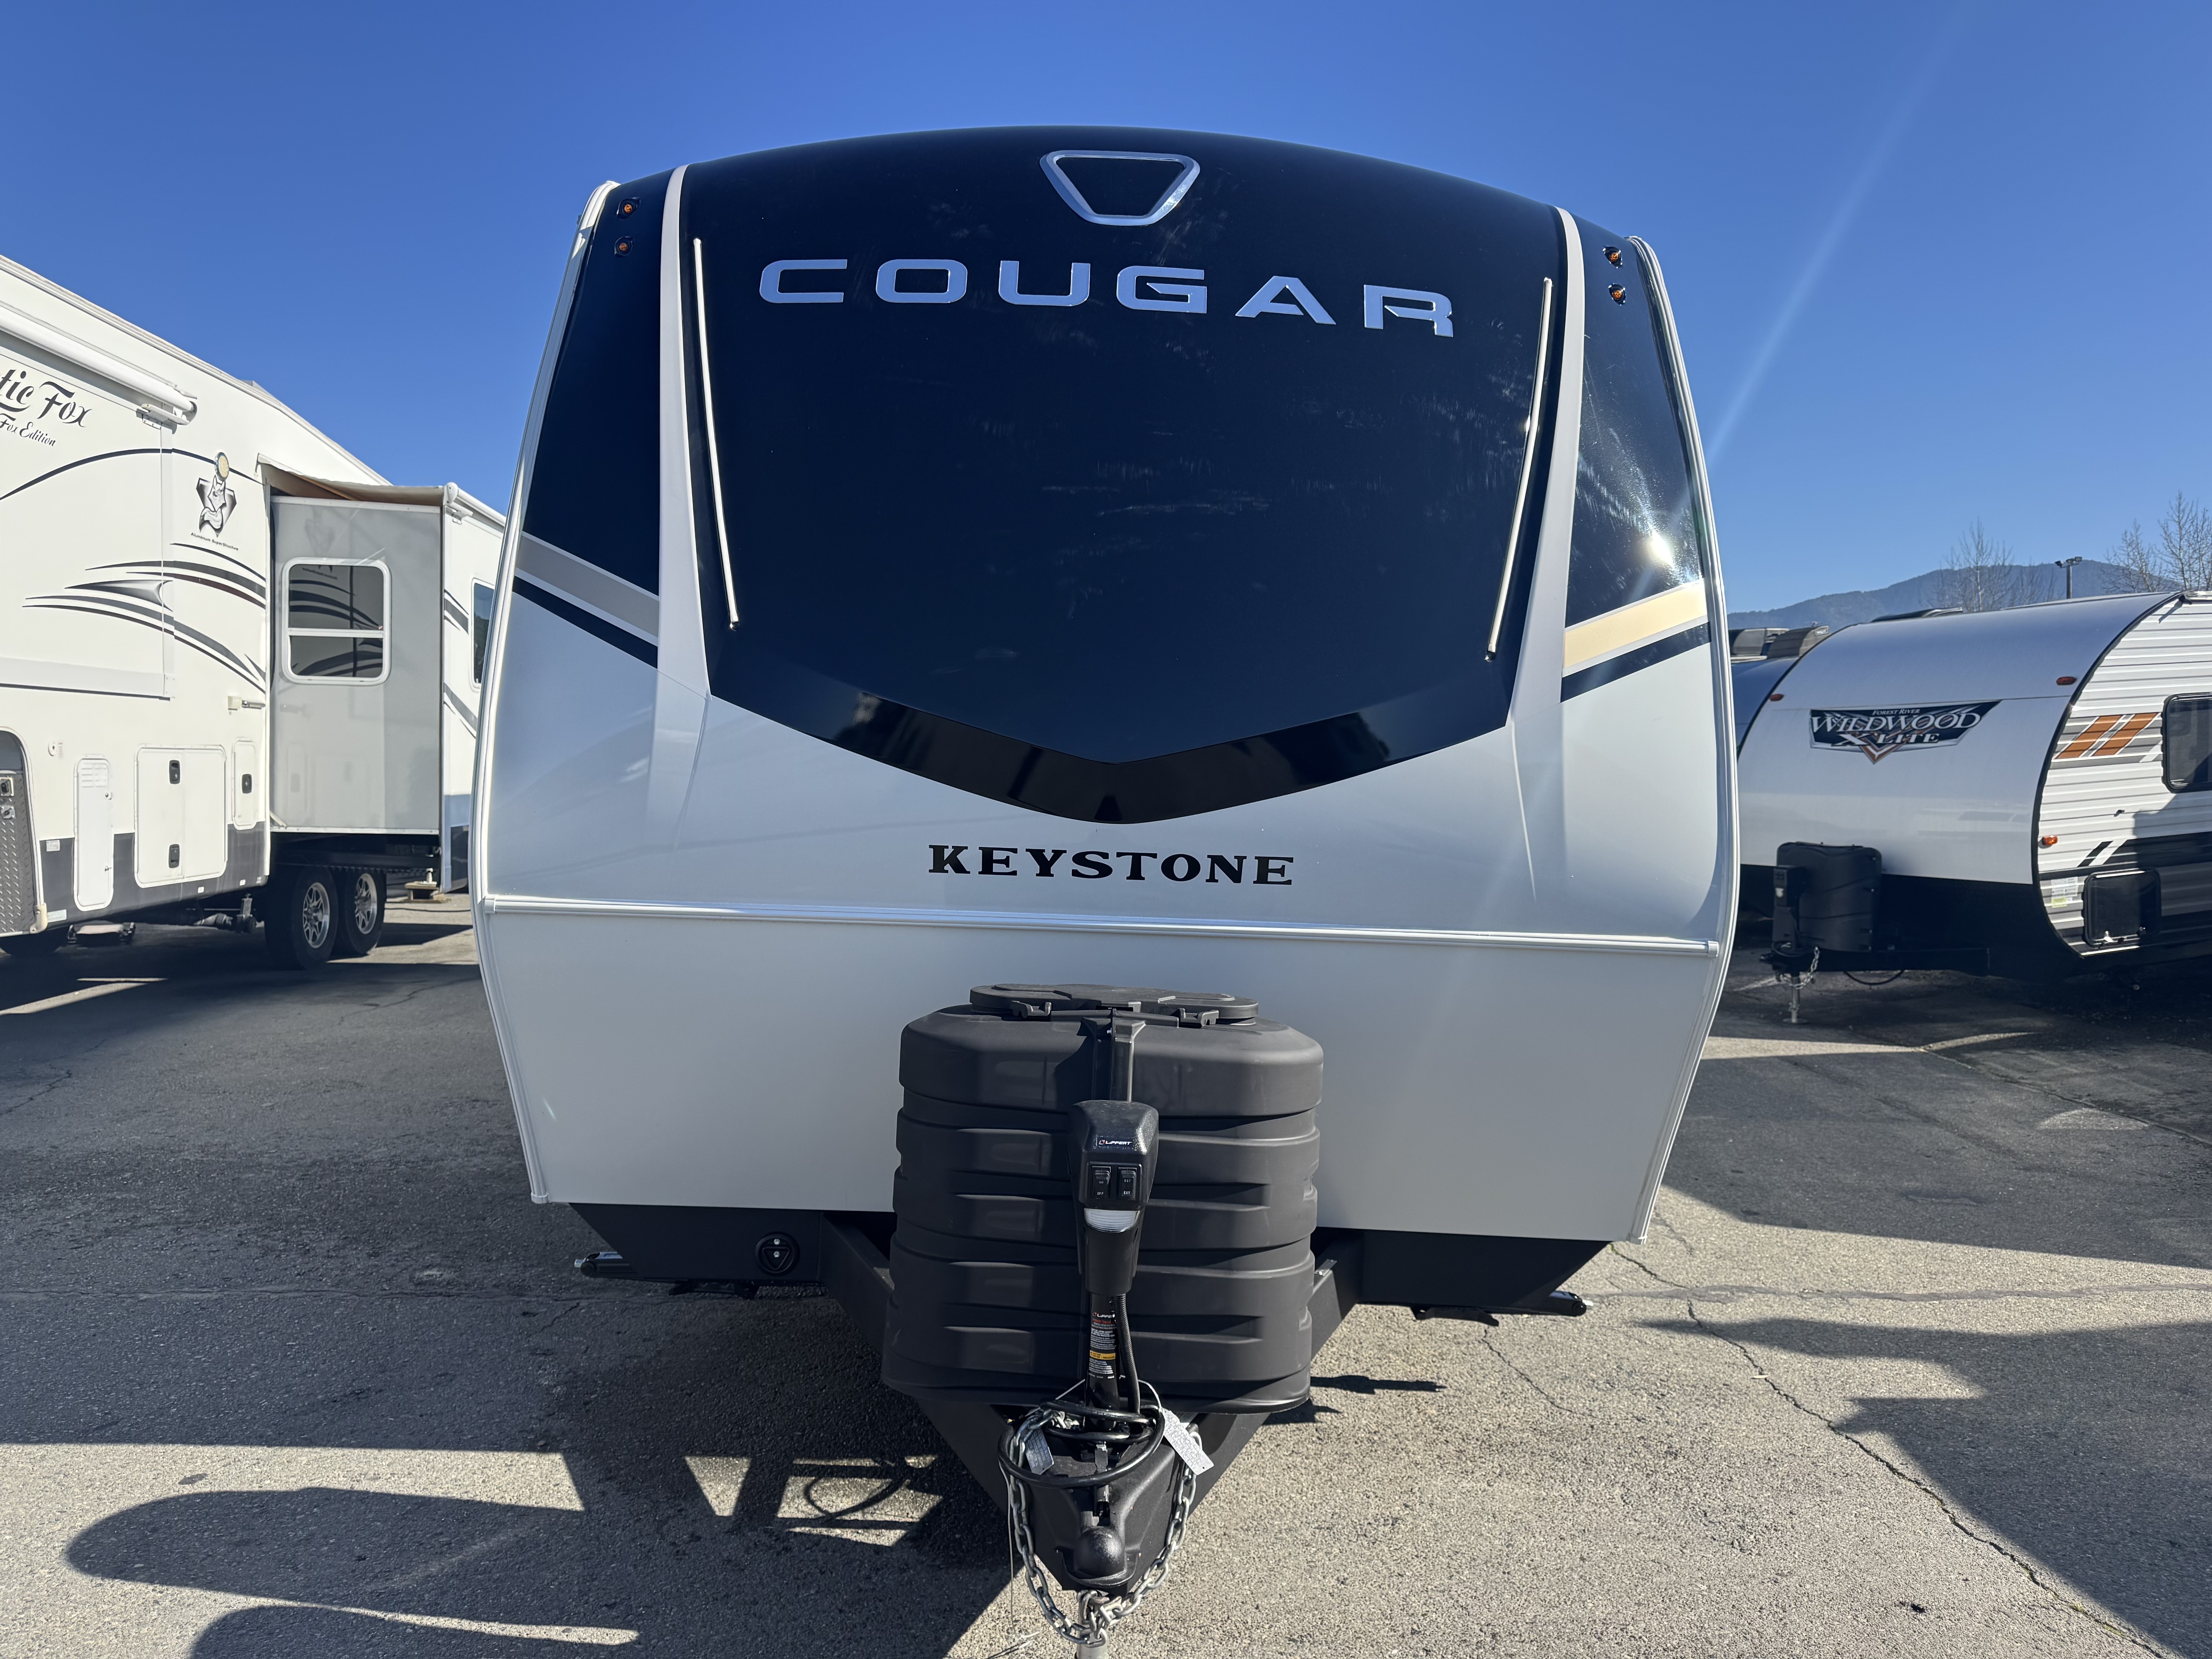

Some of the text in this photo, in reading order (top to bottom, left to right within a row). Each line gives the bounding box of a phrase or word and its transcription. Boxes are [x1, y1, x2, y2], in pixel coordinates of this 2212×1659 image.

[759, 258, 1454, 338] COUGAR
[0, 369, 92, 428] tic Fox
[0, 413, 56, 447] Fox Edition
[191, 532, 211, 541] Aluminum
[1811, 713, 1981, 732] WILDWOOD
[1831, 733, 1940, 746] X LITE
[928, 844, 1294, 886] KEYSTONE
